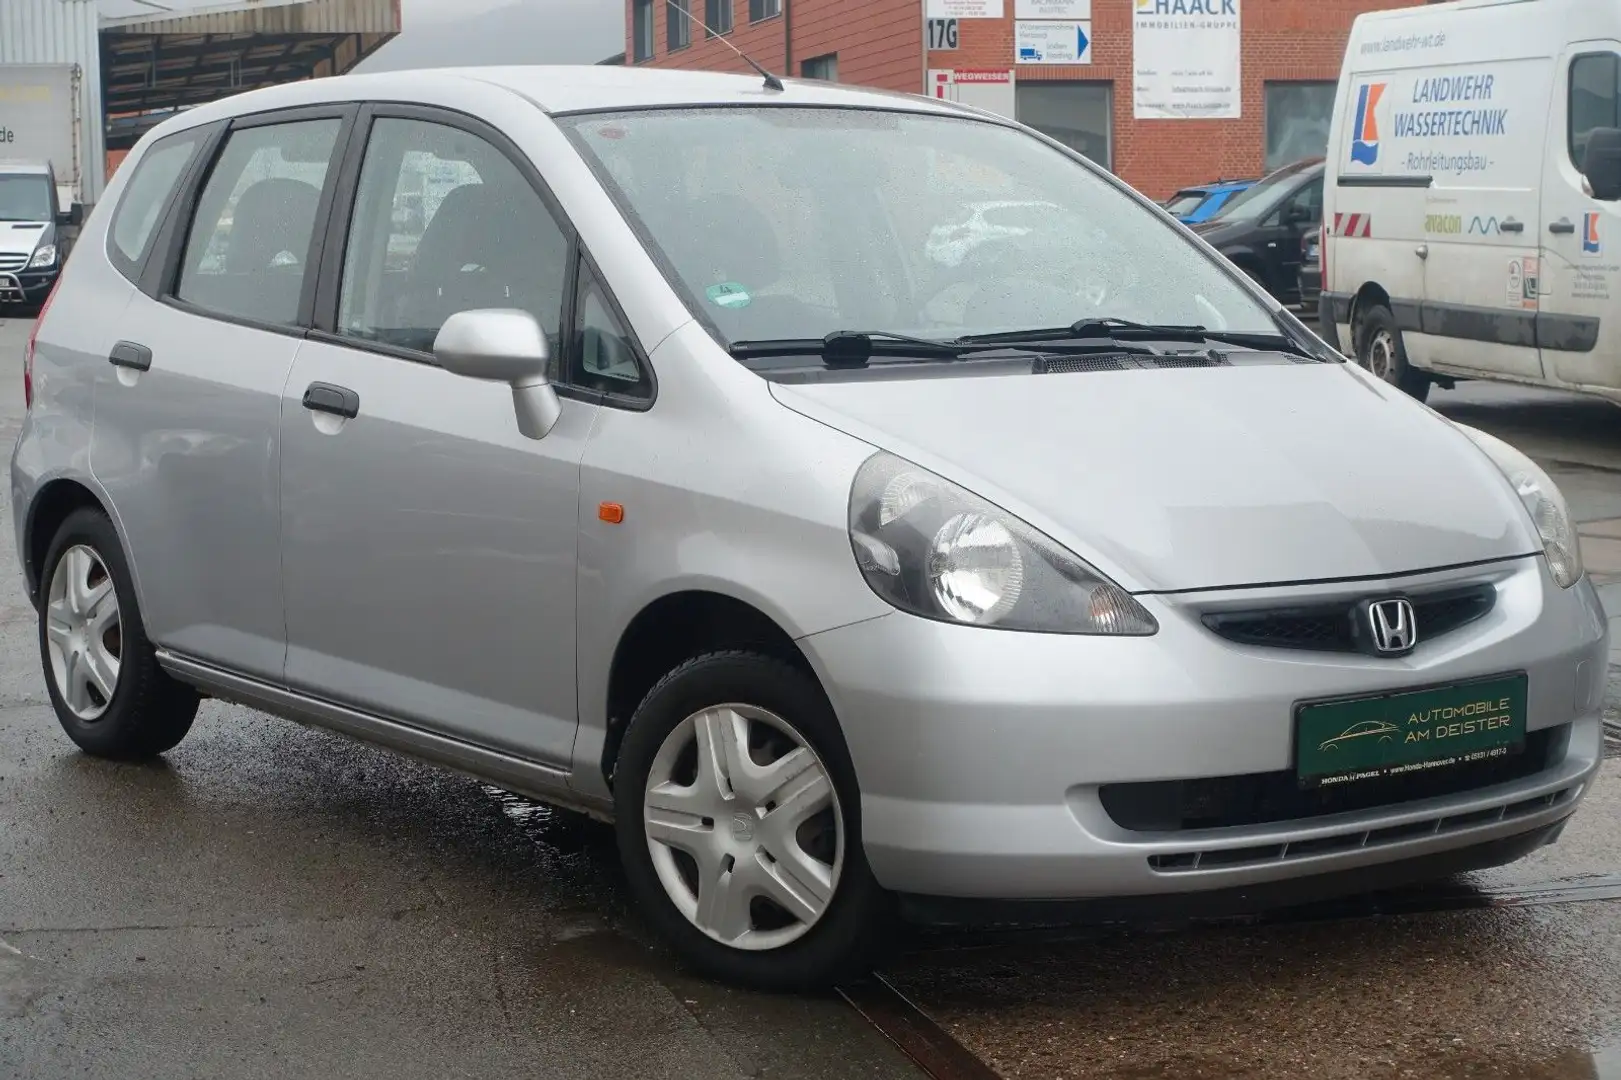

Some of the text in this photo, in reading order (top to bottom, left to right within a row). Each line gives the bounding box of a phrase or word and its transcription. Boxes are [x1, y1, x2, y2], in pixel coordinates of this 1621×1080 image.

[1155, 0, 1236, 14] HAACK
[928, 19, 957, 49] 17G
[1136, 20, 1237, 30] IMMOBILIEN-GRUPPE
[954, 72, 1010, 81] WEGWEISER
[1412, 74, 1495, 103] LANDWEHR
[1394, 109, 1508, 137] WASSERTECHNIK
[1407, 150, 1487, 175] Rohrleitungsbau
[1424, 214, 1462, 234] avacon
[1407, 697, 1510, 725] AUTOMOBILE
[1404, 714, 1511, 744] AM DEISTER
[1321, 775, 1349, 785] HONDA
